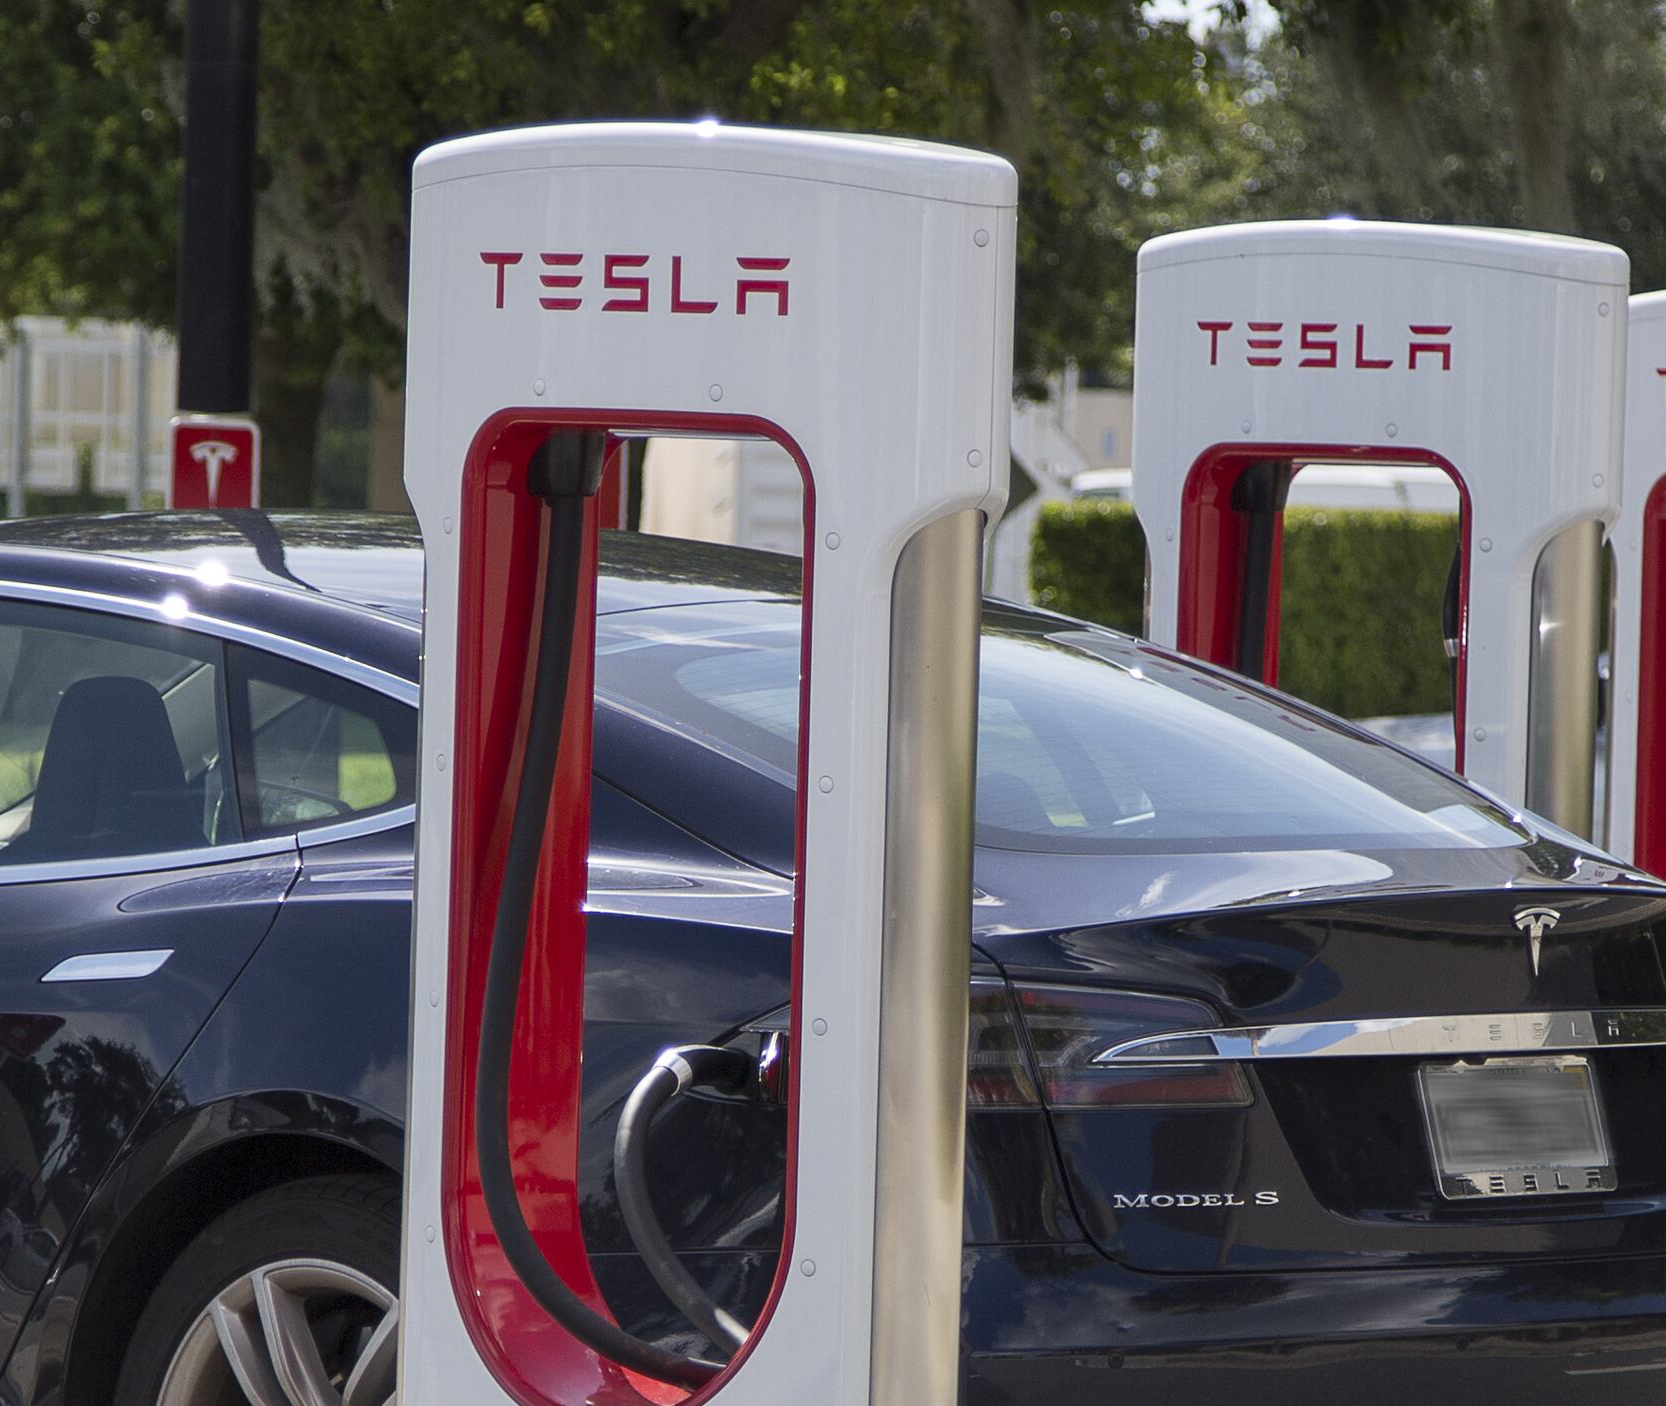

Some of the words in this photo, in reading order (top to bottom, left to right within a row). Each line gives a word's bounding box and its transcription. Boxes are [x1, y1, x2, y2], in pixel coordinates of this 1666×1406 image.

[479, 251, 791, 316] TESLA
[1196, 321, 1453, 371] TESLA
[1442, 1019, 1620, 1042] TESLA
[1455, 1169, 1601, 1197] TESLA
[1113, 1193, 1245, 1209] MODEL
[1254, 1191, 1280, 1206] S
